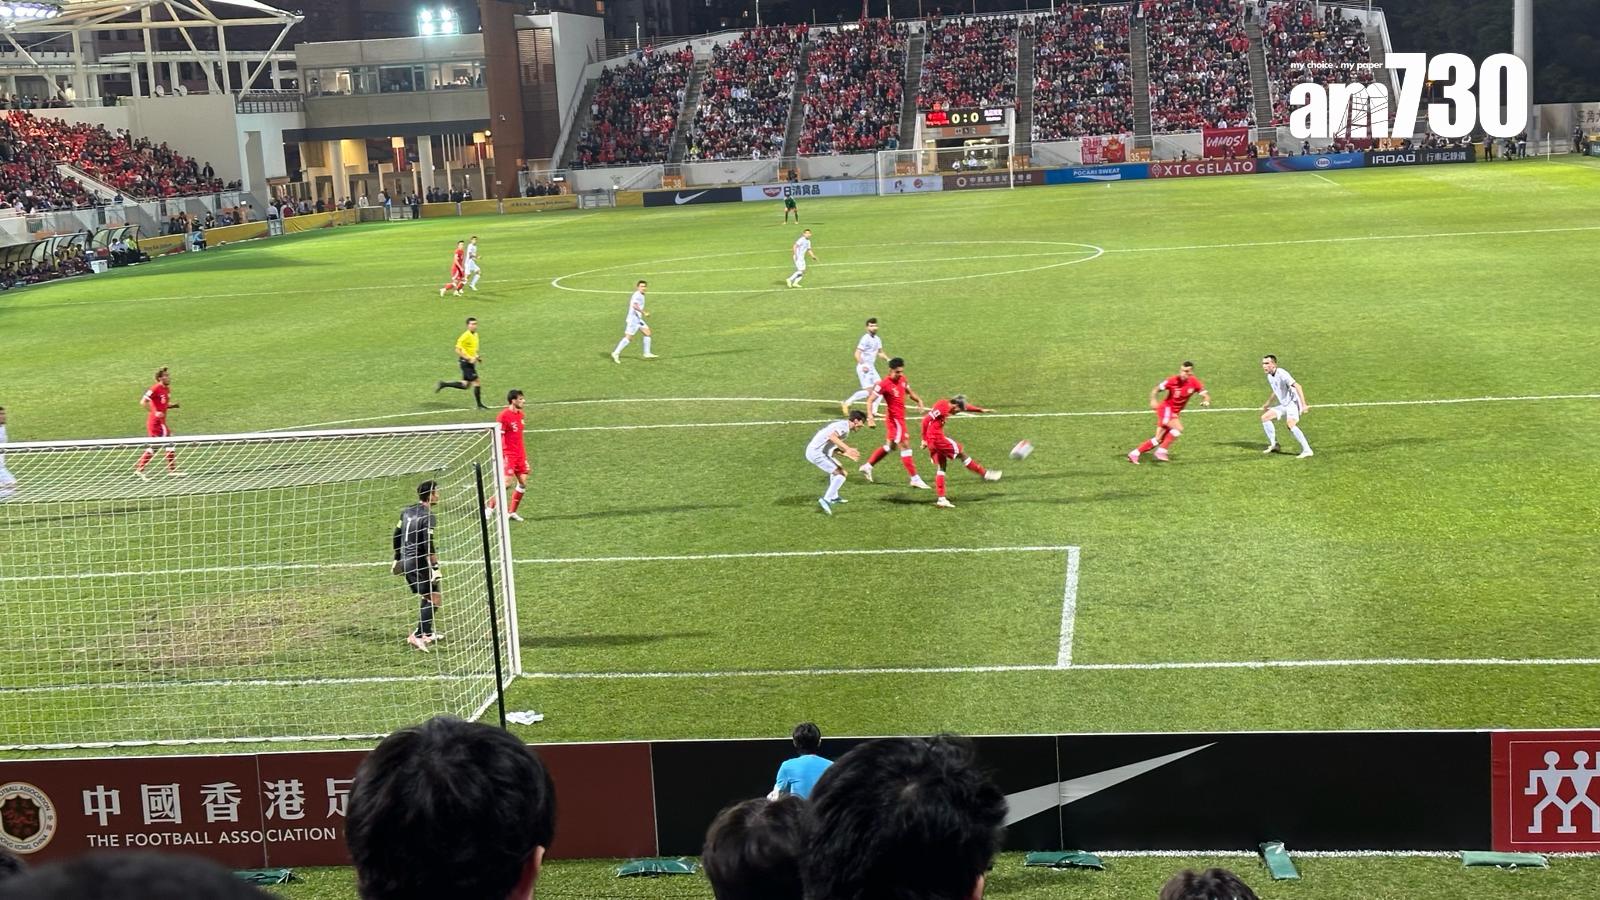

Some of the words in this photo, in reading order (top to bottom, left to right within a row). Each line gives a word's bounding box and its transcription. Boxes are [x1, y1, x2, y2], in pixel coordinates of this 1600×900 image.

[1206, 135, 1246, 147] VAMOS!
[1372, 154, 1416, 164] IROAD
[1164, 164, 1191, 176] XTC
[1195, 161, 1253, 174] GELATO
[783, 184, 820, 198] 日清食品
[86, 834, 120, 848] THE
[125, 831, 213, 846] FOOTBALL
[218, 827, 337, 844] ASSOCIATION
